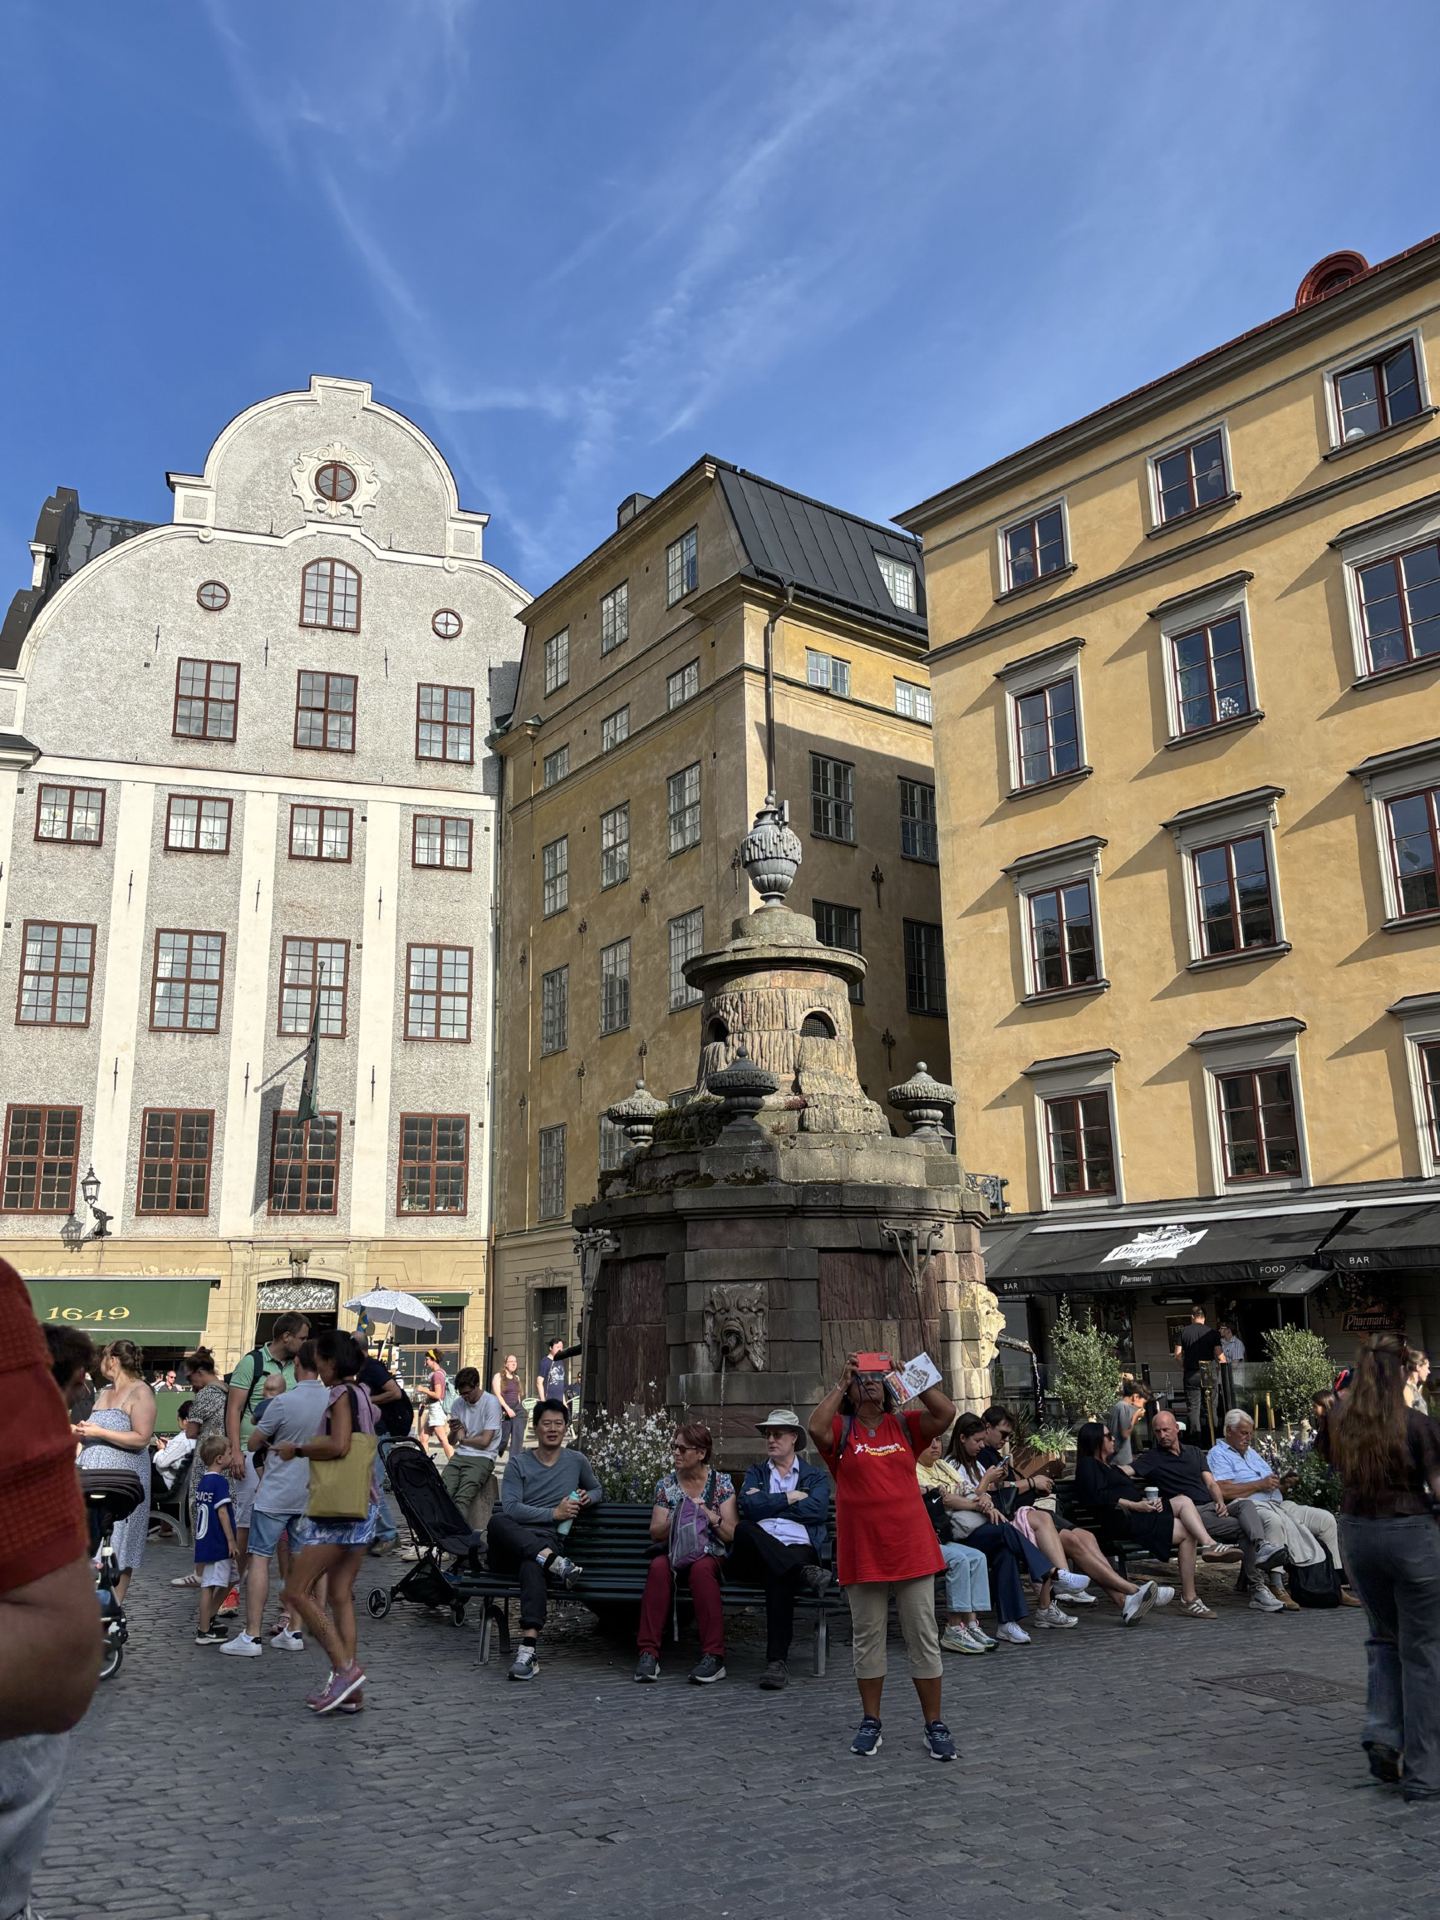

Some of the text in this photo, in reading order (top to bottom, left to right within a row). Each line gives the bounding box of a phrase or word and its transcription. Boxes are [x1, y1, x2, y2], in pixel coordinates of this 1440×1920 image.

[1349, 1256, 1370, 1265] BAR
[1259, 1265, 1286, 1274] FOOD
[1003, 1282, 1019, 1290] BAR
[45, 1306, 131, 1321] 1649
